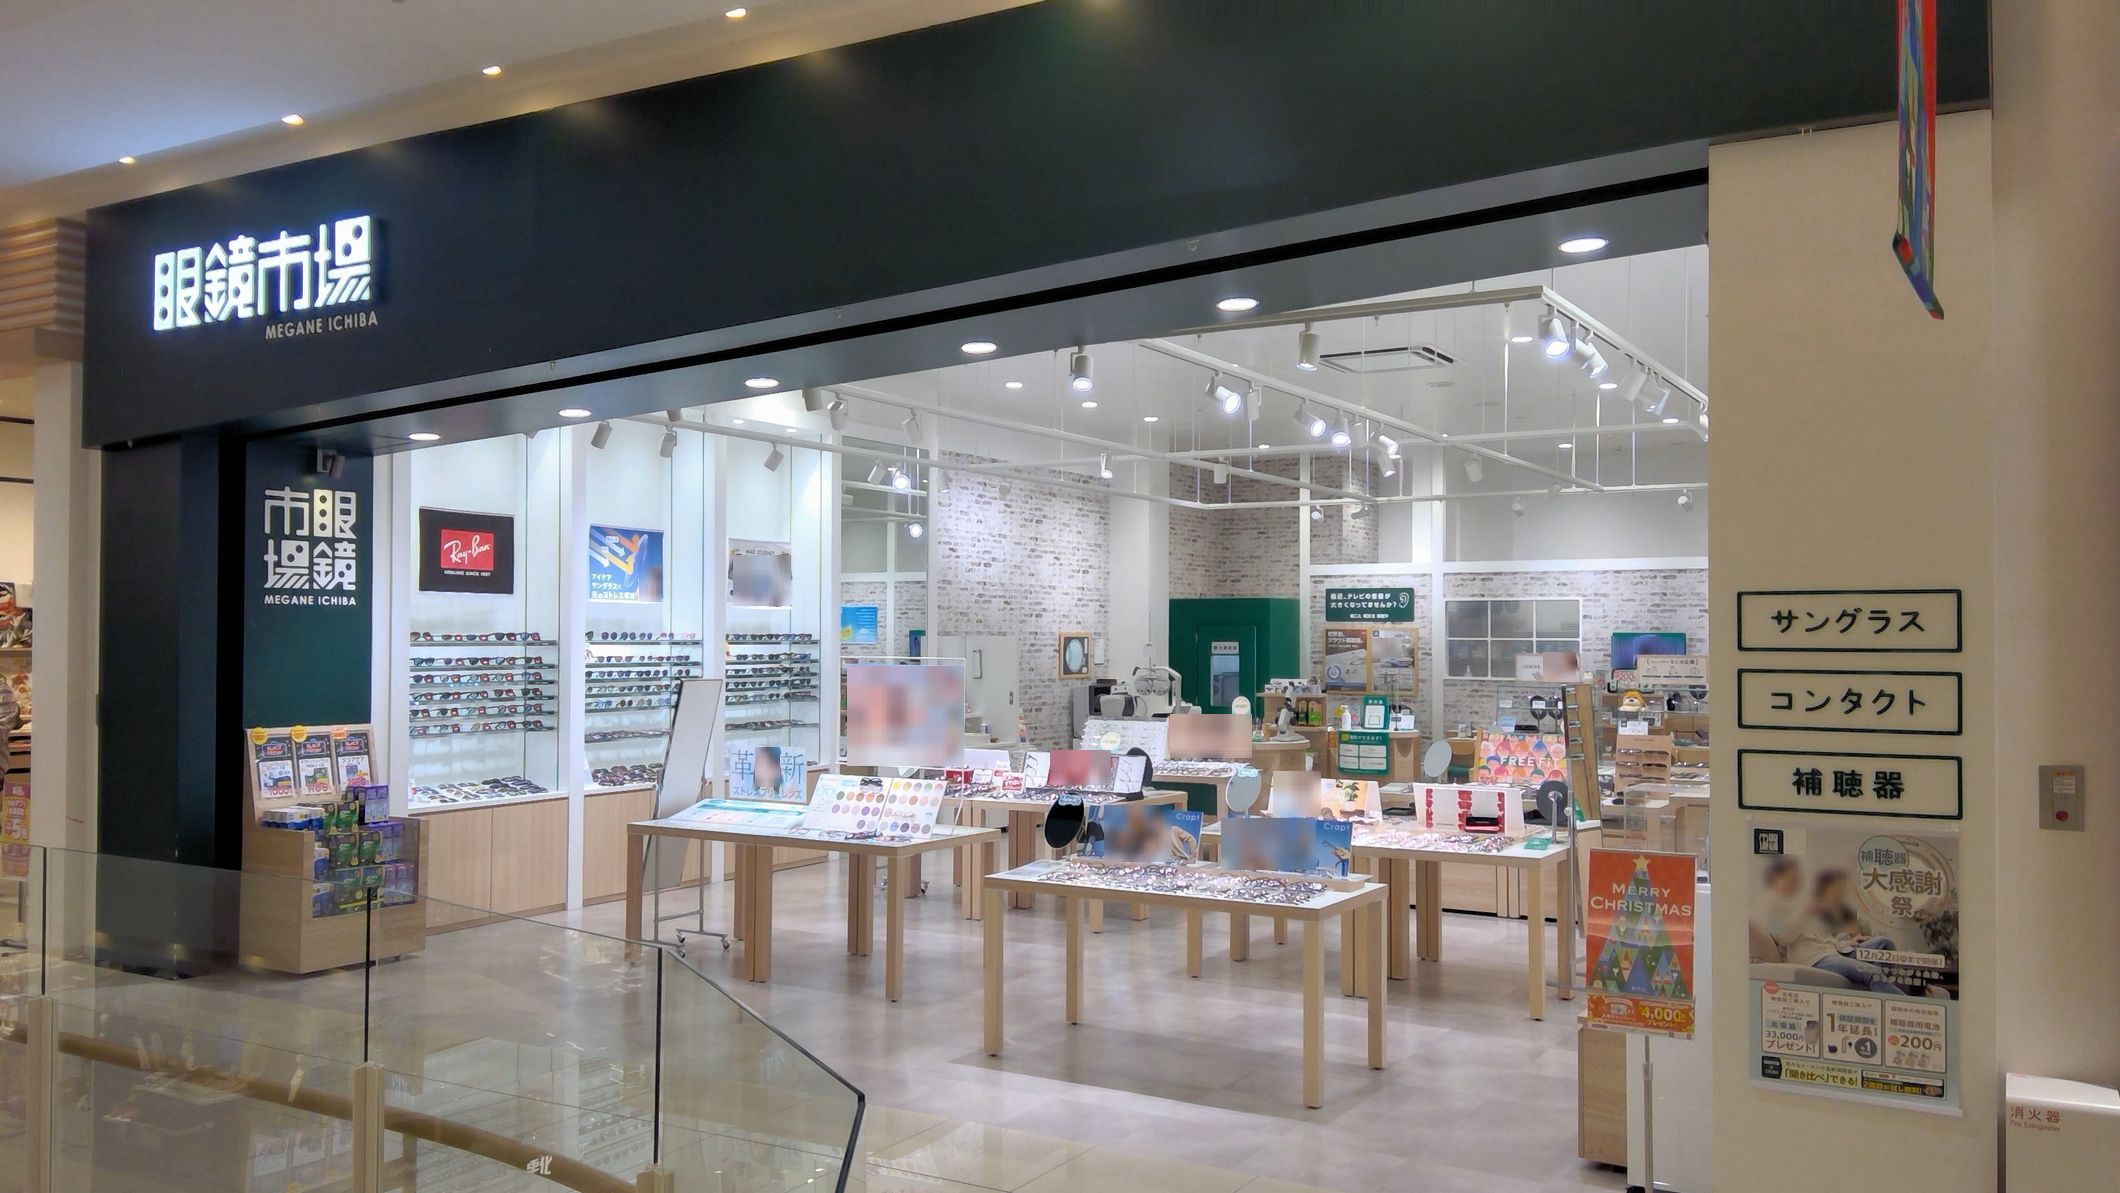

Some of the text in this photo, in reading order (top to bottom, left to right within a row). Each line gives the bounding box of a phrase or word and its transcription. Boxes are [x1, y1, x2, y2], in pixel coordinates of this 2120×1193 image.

[153, 215, 371, 331] 眼鏡市場
[265, 311, 378, 340] MEGANE ICHIBA
[443, 534, 491, 565] Ray-Ban
[264, 594, 356, 606] MEGANE ICHIBA
[1771, 607, 1925, 634] サングラス
[1771, 688, 1926, 715] コンタクト
[1500, 755, 1535, 767] FREE
[1792, 767, 1905, 799] 補聴器
[1860, 848, 1907, 866] 補聴器
[1612, 883, 1671, 898] MERRY
[1861, 867, 1944, 896] 大感謝
[1590, 896, 1692, 916] CHRISTMAS
[1890, 896, 1914, 917] 祭
[1900, 1035, 1942, 1052] 200円
[2010, 1106, 2061, 1124] 消火器
